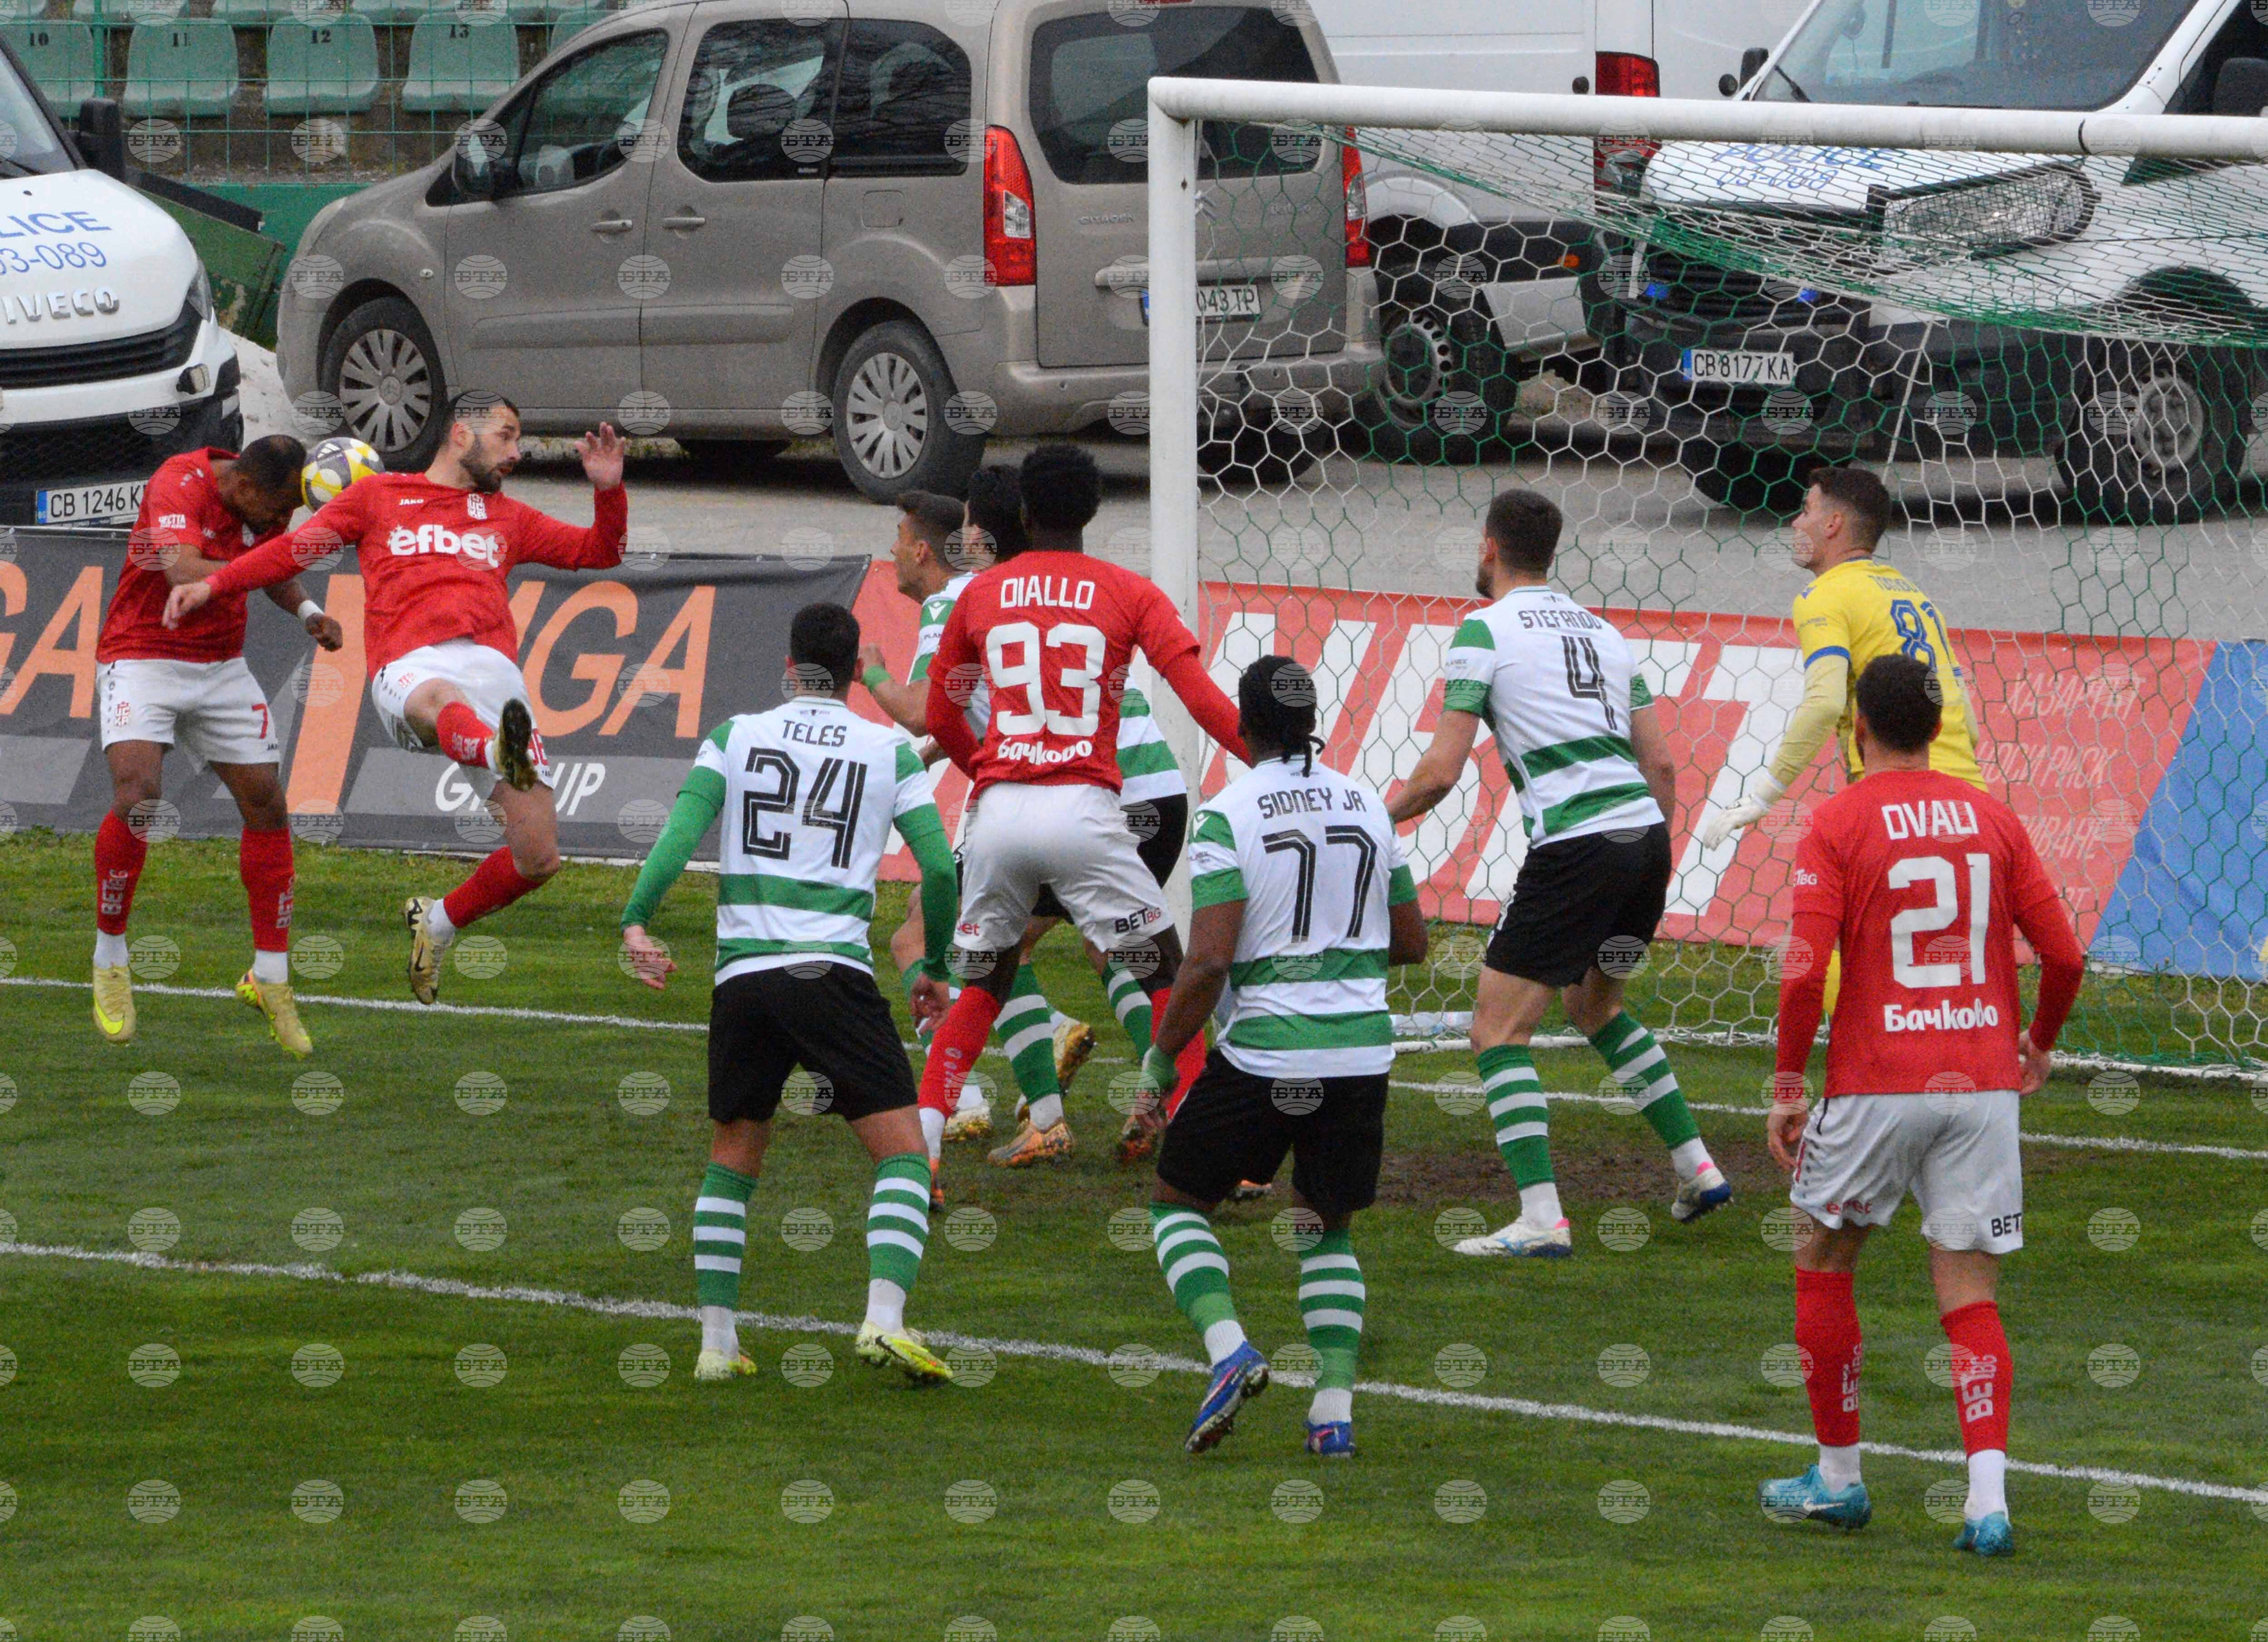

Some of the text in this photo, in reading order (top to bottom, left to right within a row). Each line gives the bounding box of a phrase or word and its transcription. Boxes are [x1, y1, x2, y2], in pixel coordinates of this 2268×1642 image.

[29, 32, 49, 46] 10
[172, 32, 188, 47] 11
[311, 29, 331, 44] 12
[0, 242, 107, 275] 3-089
[1, 286, 120, 324] IVECO
[1196, 289, 1230, 313] 043
[50, 484, 146, 518] CB 1246 K
[390, 524, 500, 568] efbet
[1000, 575, 1095, 610] DIALLO
[986, 621, 1106, 737] 93
[1561, 635, 1618, 730] 4
[251, 703, 269, 739] 7
[782, 719, 847, 748] TELES
[435, 762, 606, 816] GUP
[1256, 787, 1367, 819] SIDNEY JR
[743, 747, 868, 869] 24
[1261, 825, 1378, 943] 77
[1793, 868, 1817, 886] TBG
[1887, 853, 1991, 988] 21
[1990, 1212, 2023, 1238] BET
